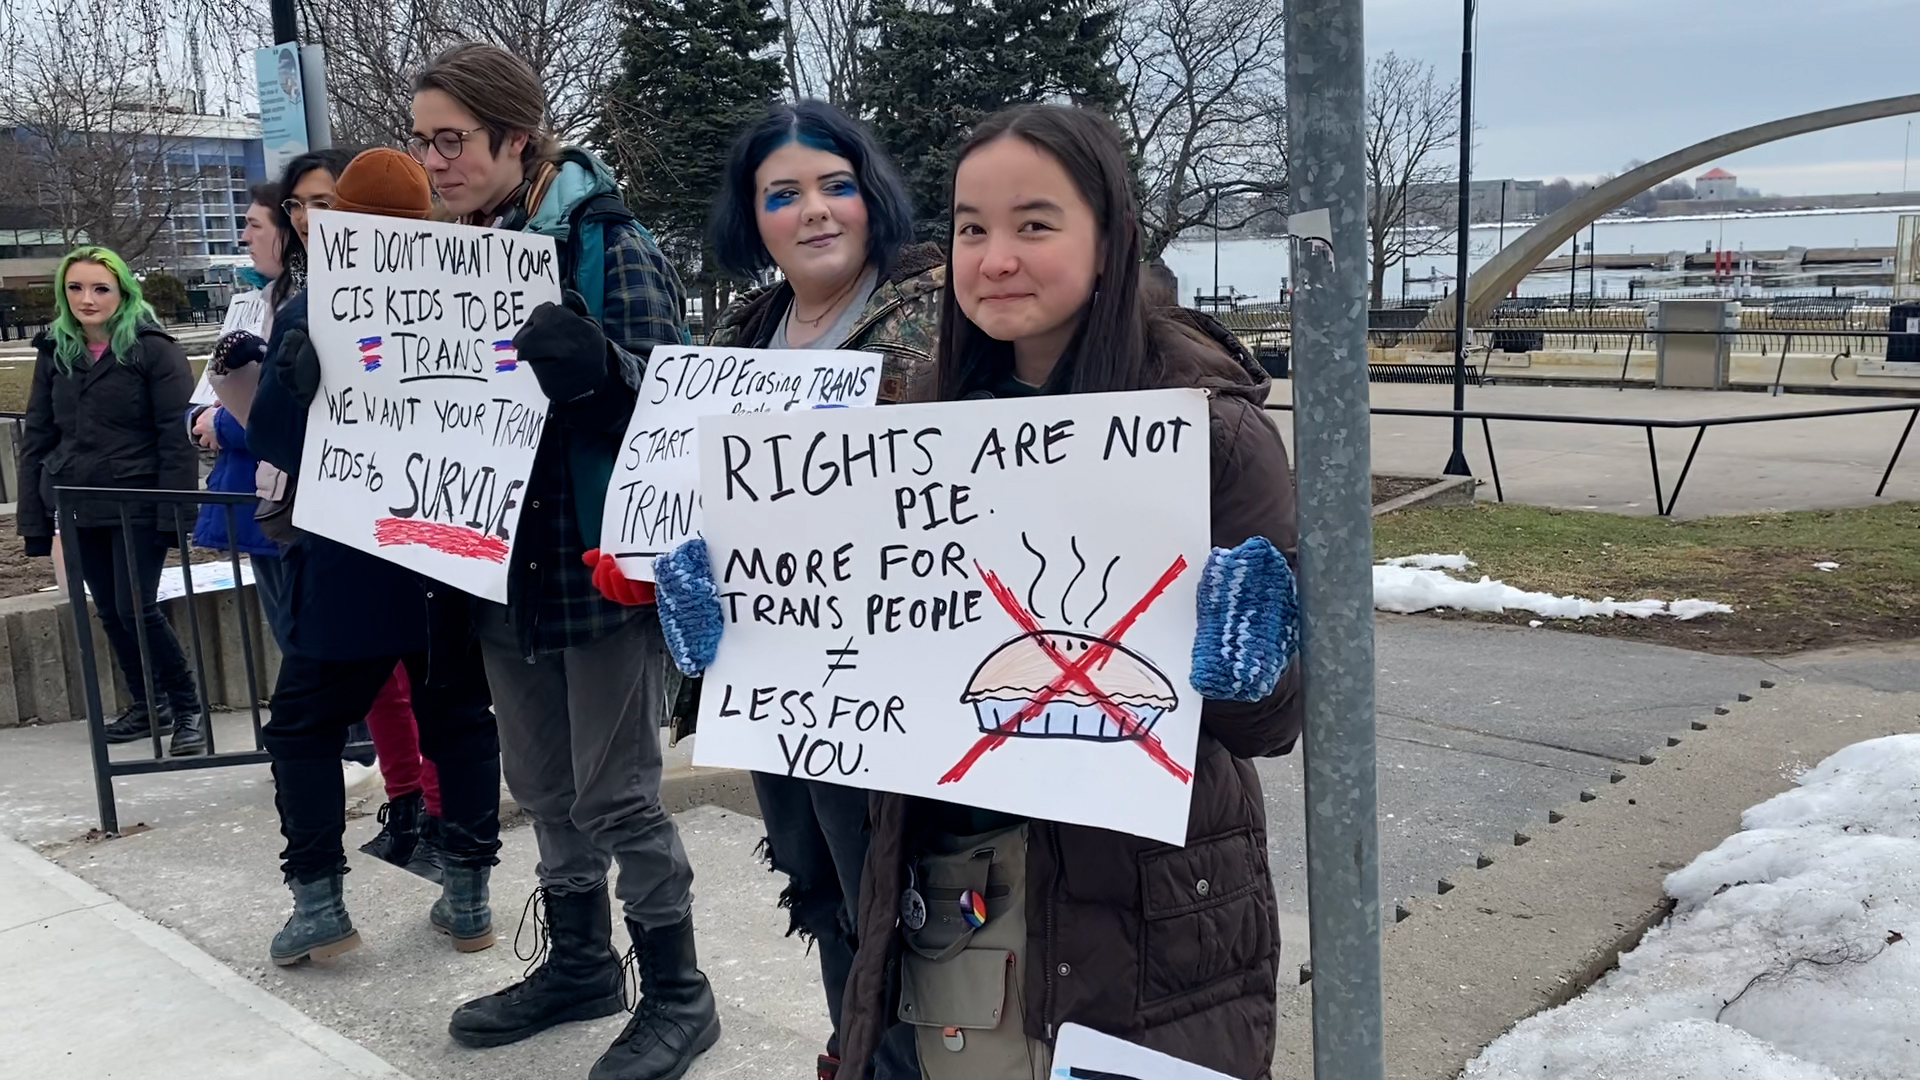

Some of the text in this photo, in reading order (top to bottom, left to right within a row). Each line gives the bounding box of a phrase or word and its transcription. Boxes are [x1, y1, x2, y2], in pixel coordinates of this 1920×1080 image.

[320, 223, 555, 284] WE DON'T WANT YOUR
[331, 286, 525, 332] CIS KIDS TO BE
[391, 332, 485, 376] TRANS
[651, 353, 875, 411] STOP Erasing TRANS
[324, 386, 544, 450] WE WANT YOUR TRANS
[723, 415, 1192, 502] RIGHTS ARE NOT
[318, 439, 525, 540] KIDS to SURVIVE
[619, 480, 703, 546] TRAN
[896, 482, 995, 530] PIE.
[723, 541, 969, 588] MORE FOR
[720, 590, 984, 635] TRANS PEOPLE
[719, 684, 907, 734] LESS FOR
[778, 733, 869, 778] YOU.
